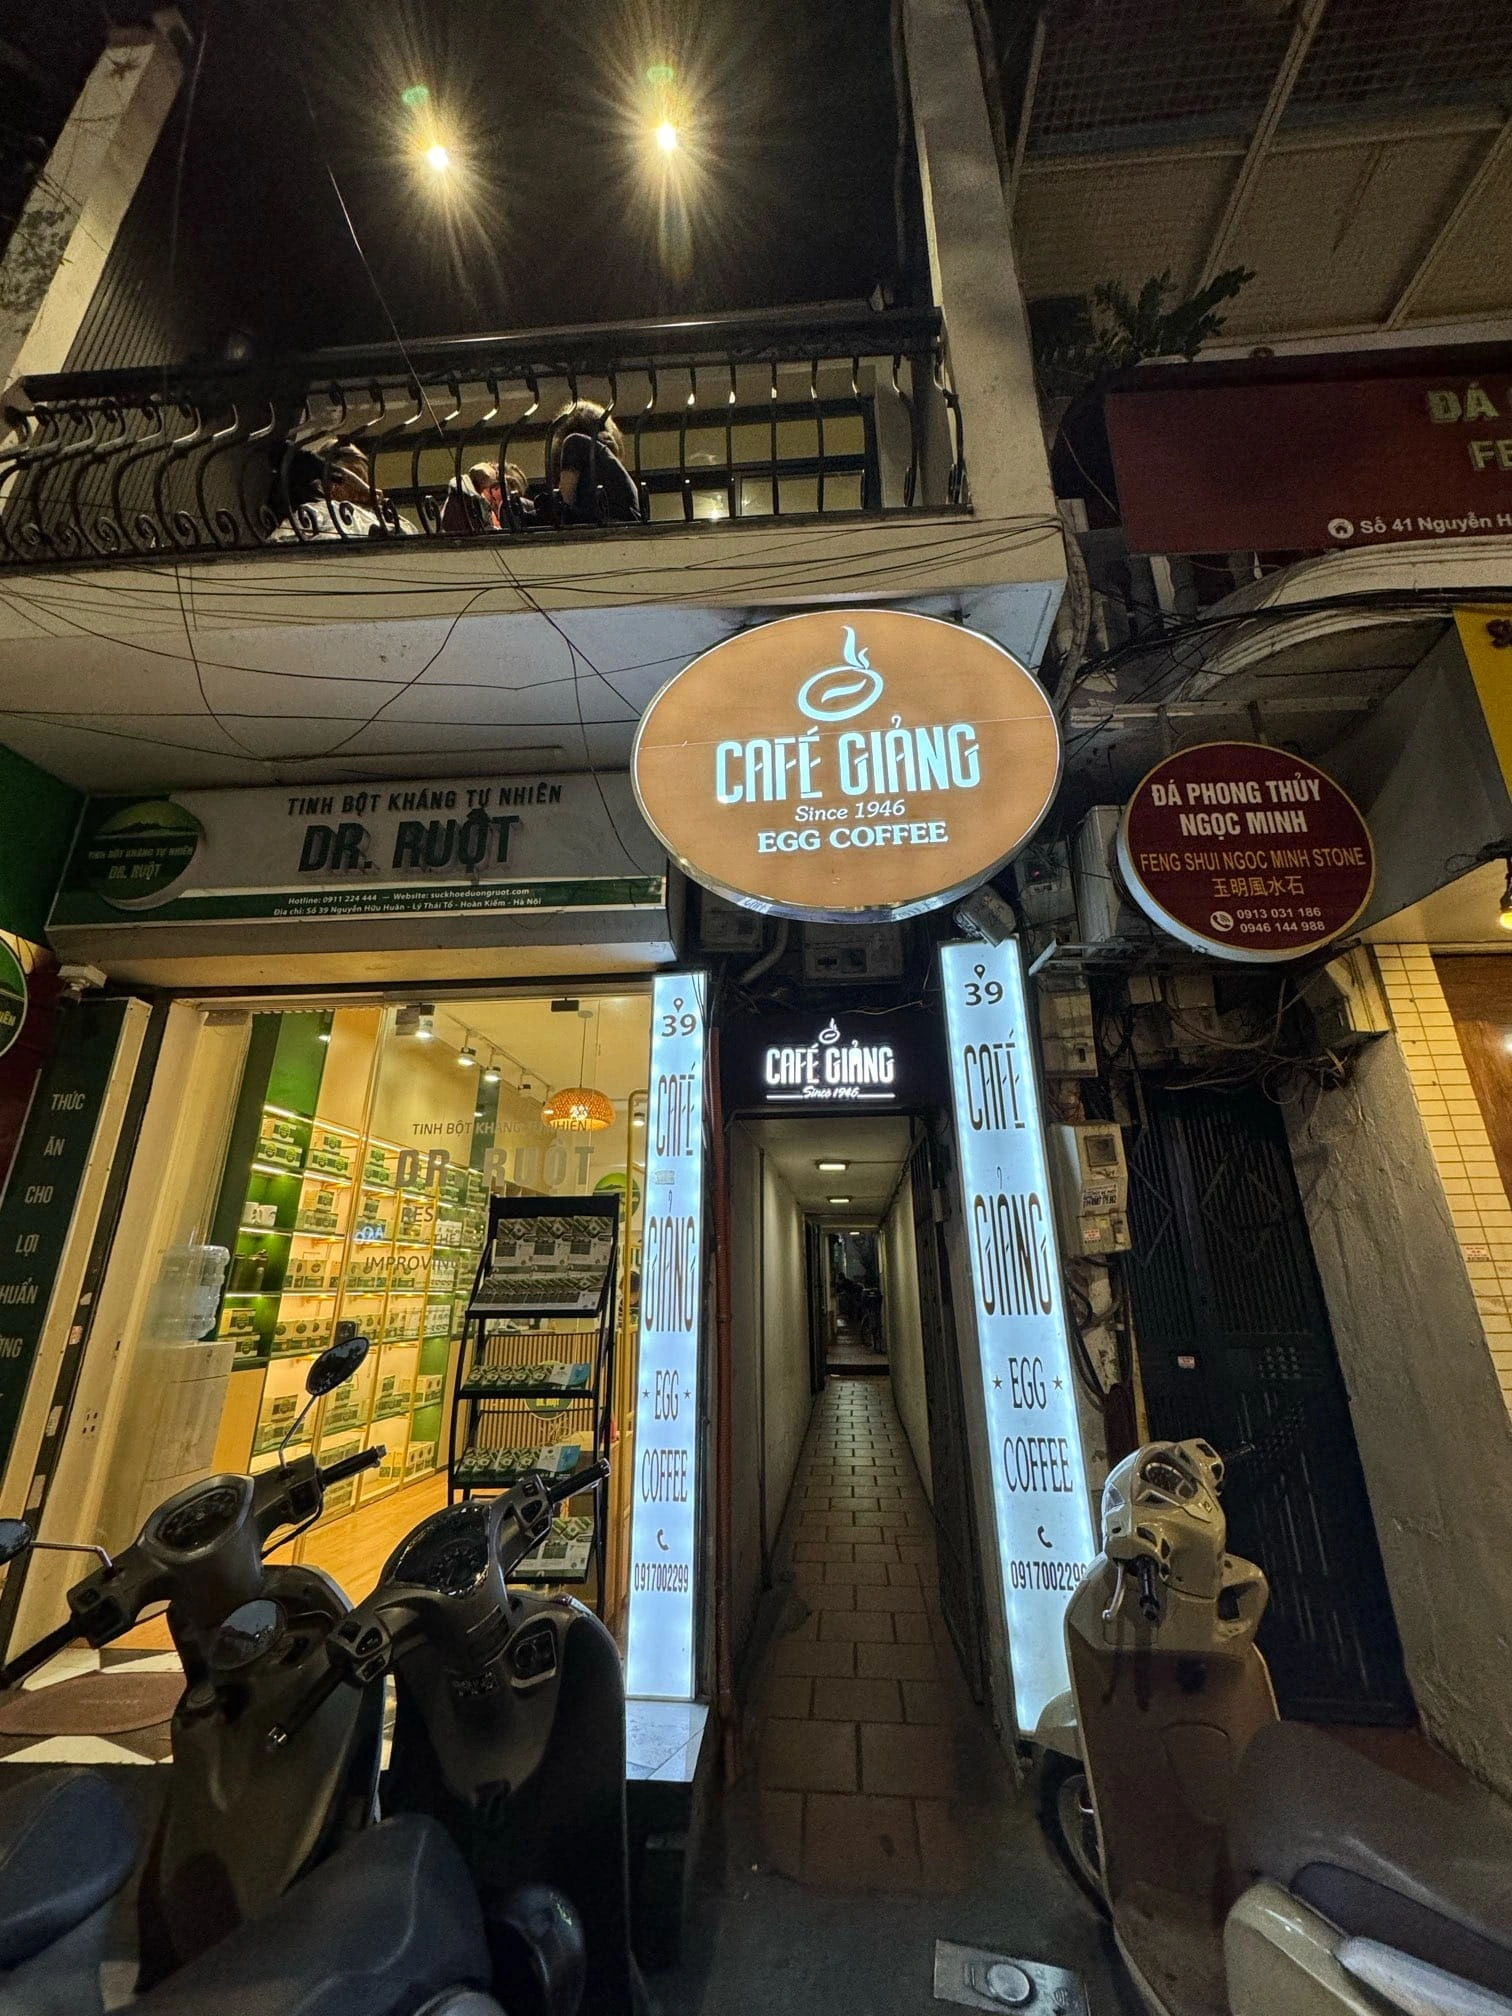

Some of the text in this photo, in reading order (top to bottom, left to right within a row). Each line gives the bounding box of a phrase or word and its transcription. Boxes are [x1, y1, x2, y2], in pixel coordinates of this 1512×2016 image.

[1427, 381, 1500, 423] ĐÁ
[1360, 516, 1387, 534] Số
[1392, 518, 1412, 532] 41
[1418, 511, 1492, 534] Nguyễn
[715, 715, 981, 804] CAFÉ GIẢNG
[288, 782, 562, 816] TINH BỘT KHÁNG TỰ NHIÊN
[1151, 772, 1321, 806] ĐÁ PHONG THỦY
[794, 799, 905, 822] Since 1946
[1179, 810, 1308, 840] NGỌC MINH
[298, 808, 520, 874] DR. RUỘT
[757, 821, 948, 854] EGG COFFEE
[1140, 847, 1367, 872] FENG SHUI NGOC MINH STONE
[288, 887, 530, 905] Hotline: 0911 224 444 Website: suckhoeduongruot.com
[1211, 876, 1306, 898] 玉明風水石
[274, 907, 292, 916] Địa
[306, 905, 317, 915] Số
[318, 906, 329, 914] 39
[331, 903, 363, 915] Nguyễn
[412, 900, 422, 911] Lý
[423, 900, 443, 910] Thái
[460, 898, 484, 909] Hoàn
[513, 896, 526, 906] Hà
[1236, 907, 1322, 920] 0913 031 186
[1240, 920, 1326, 933] 0946 144 988
[964, 980, 1004, 1006] 39
[661, 1013, 697, 1037] 39
[766, 1039, 895, 1085] CAFÉ GIẢNG
[802, 1085, 860, 1099] Since 1946
[964, 1027, 1026, 1131] CAFÉ
[51, 1091, 86, 1112] THỨC
[656, 1061, 696, 1157] CAFÉ
[412, 1123, 443, 1135] TINH
[446, 1121, 472, 1137] BỘT
[43, 1135, 63, 1156] ĂN
[482, 1140, 595, 1190] RUỘT
[25, 1185, 53, 1205] CHO
[973, 1166, 1052, 1316] GIẢNG
[644, 1189, 695, 1333] GIẢNG
[655, 1370, 680, 1422] EGG
[1008, 1356, 1047, 1410] EGG
[642, 1449, 688, 1502] COFFEE
[1003, 1436, 1074, 1493] COFFEE
[634, 1562, 689, 1593] 0917002299
